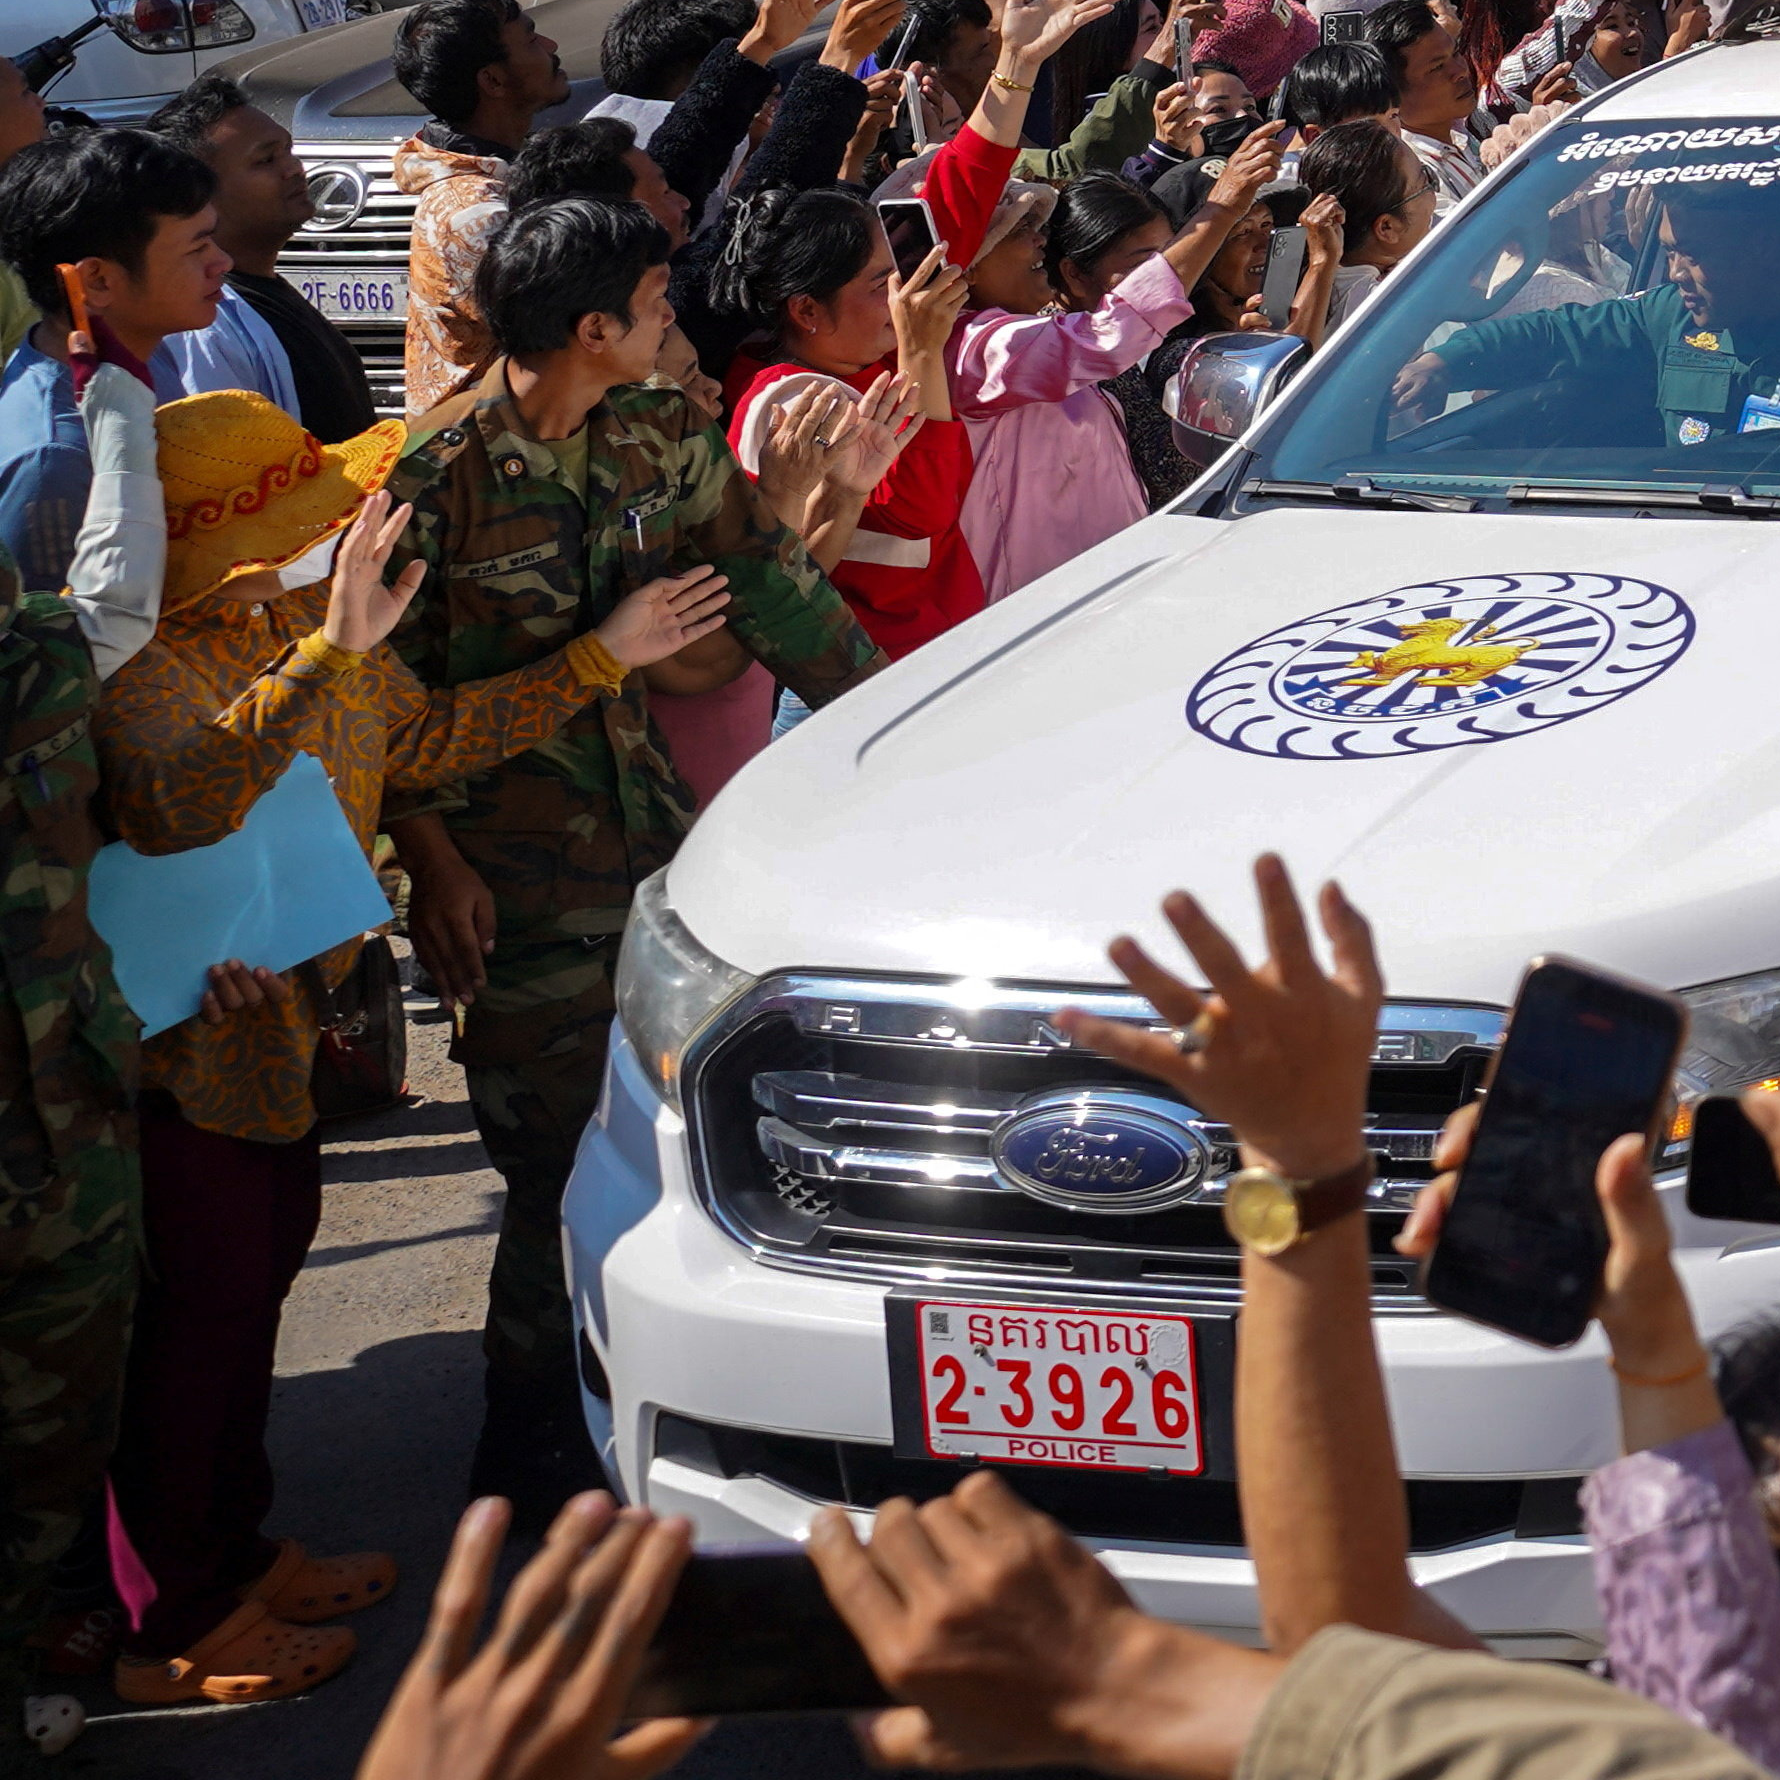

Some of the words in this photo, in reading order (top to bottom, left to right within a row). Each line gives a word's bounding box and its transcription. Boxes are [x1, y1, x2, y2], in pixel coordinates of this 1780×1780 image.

[302, 281, 394, 311] 2F-6666
[824, 1003, 1419, 1061] RANR
[1036, 1125, 1146, 1183] Ford
[967, 1313, 1152, 1356] នគរបាល
[1007, 1439, 1118, 1464] POLICE
